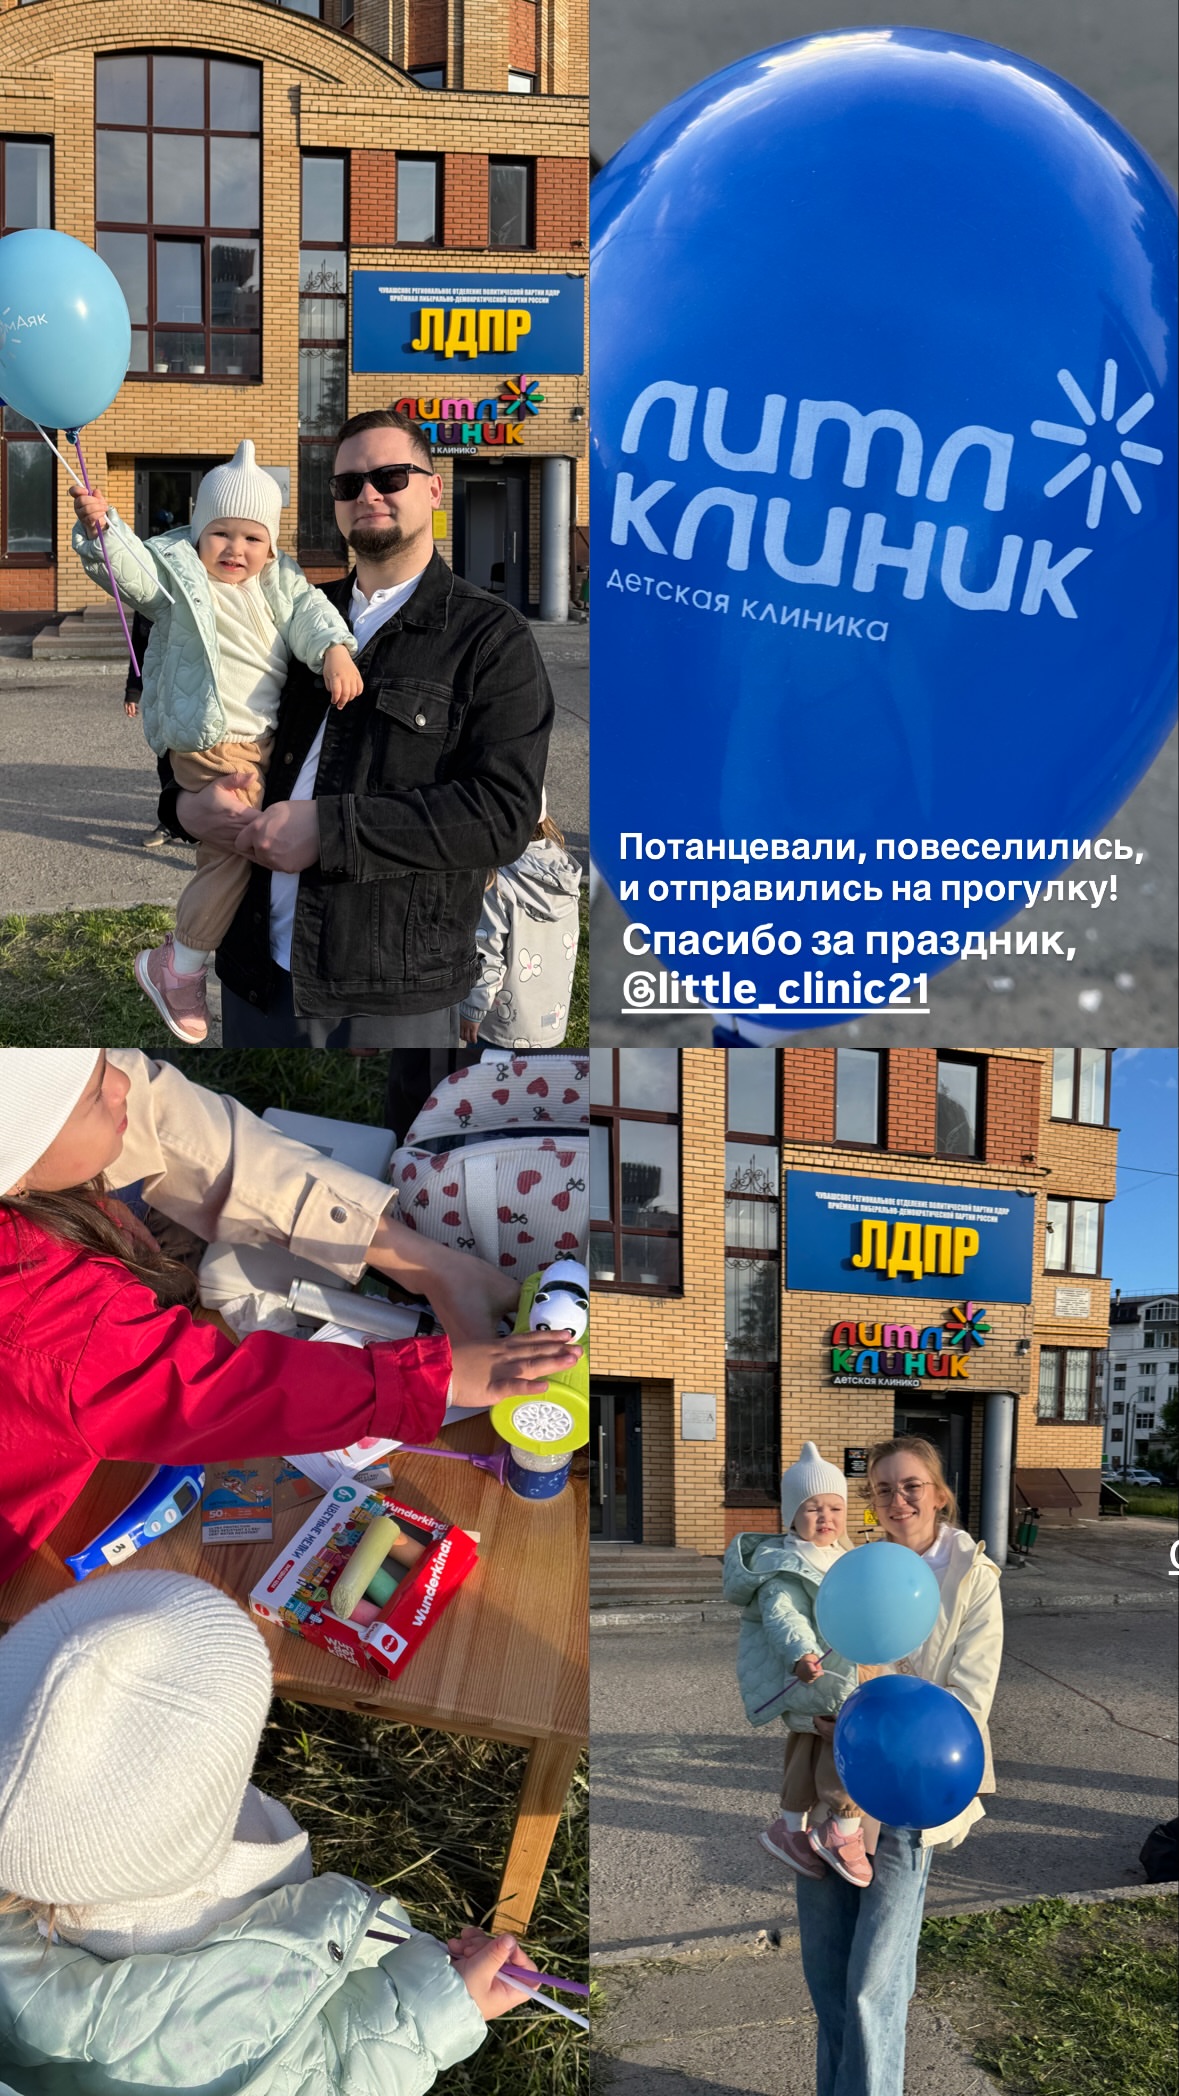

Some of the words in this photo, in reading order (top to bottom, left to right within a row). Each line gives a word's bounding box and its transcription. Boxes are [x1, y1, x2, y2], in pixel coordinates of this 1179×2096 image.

[452, 288, 482, 296] ОТДЕЛЕНИЕ
[483, 287, 524, 296] ПОЛИТИЧЕСКОЙ
[411, 307, 531, 358] ЛДПР
[621, 380, 1014, 511] литл
[610, 472, 1094, 619] клиник
[606, 568, 729, 615] детская
[741, 598, 890, 643] клиника
[896, 1198, 928, 1209] ОТДЕЛЕНИЕ
[929, 1201, 972, 1212] ПОЛИТИЧЕСКОЙ
[972, 1205, 993, 1214] ПАРТИИ
[955, 1211, 976, 1221] ПАРТИИ
[977, 1214, 998, 1223] РОССИИ
[851, 1219, 980, 1280] ЛДПР
[832, 1321, 943, 1350] литл
[831, 1349, 971, 1378] клиник
[834, 1375, 877, 1386] детская
[878, 1378, 920, 1387] клиника
[310, 1502, 341, 1536] ЦВЕТНЫЕ
[381, 1499, 449, 1531] Wunderkind!
[291, 1533, 317, 1559] МЕЛКИ
[412, 1539, 453, 1627] Wunderkind!
